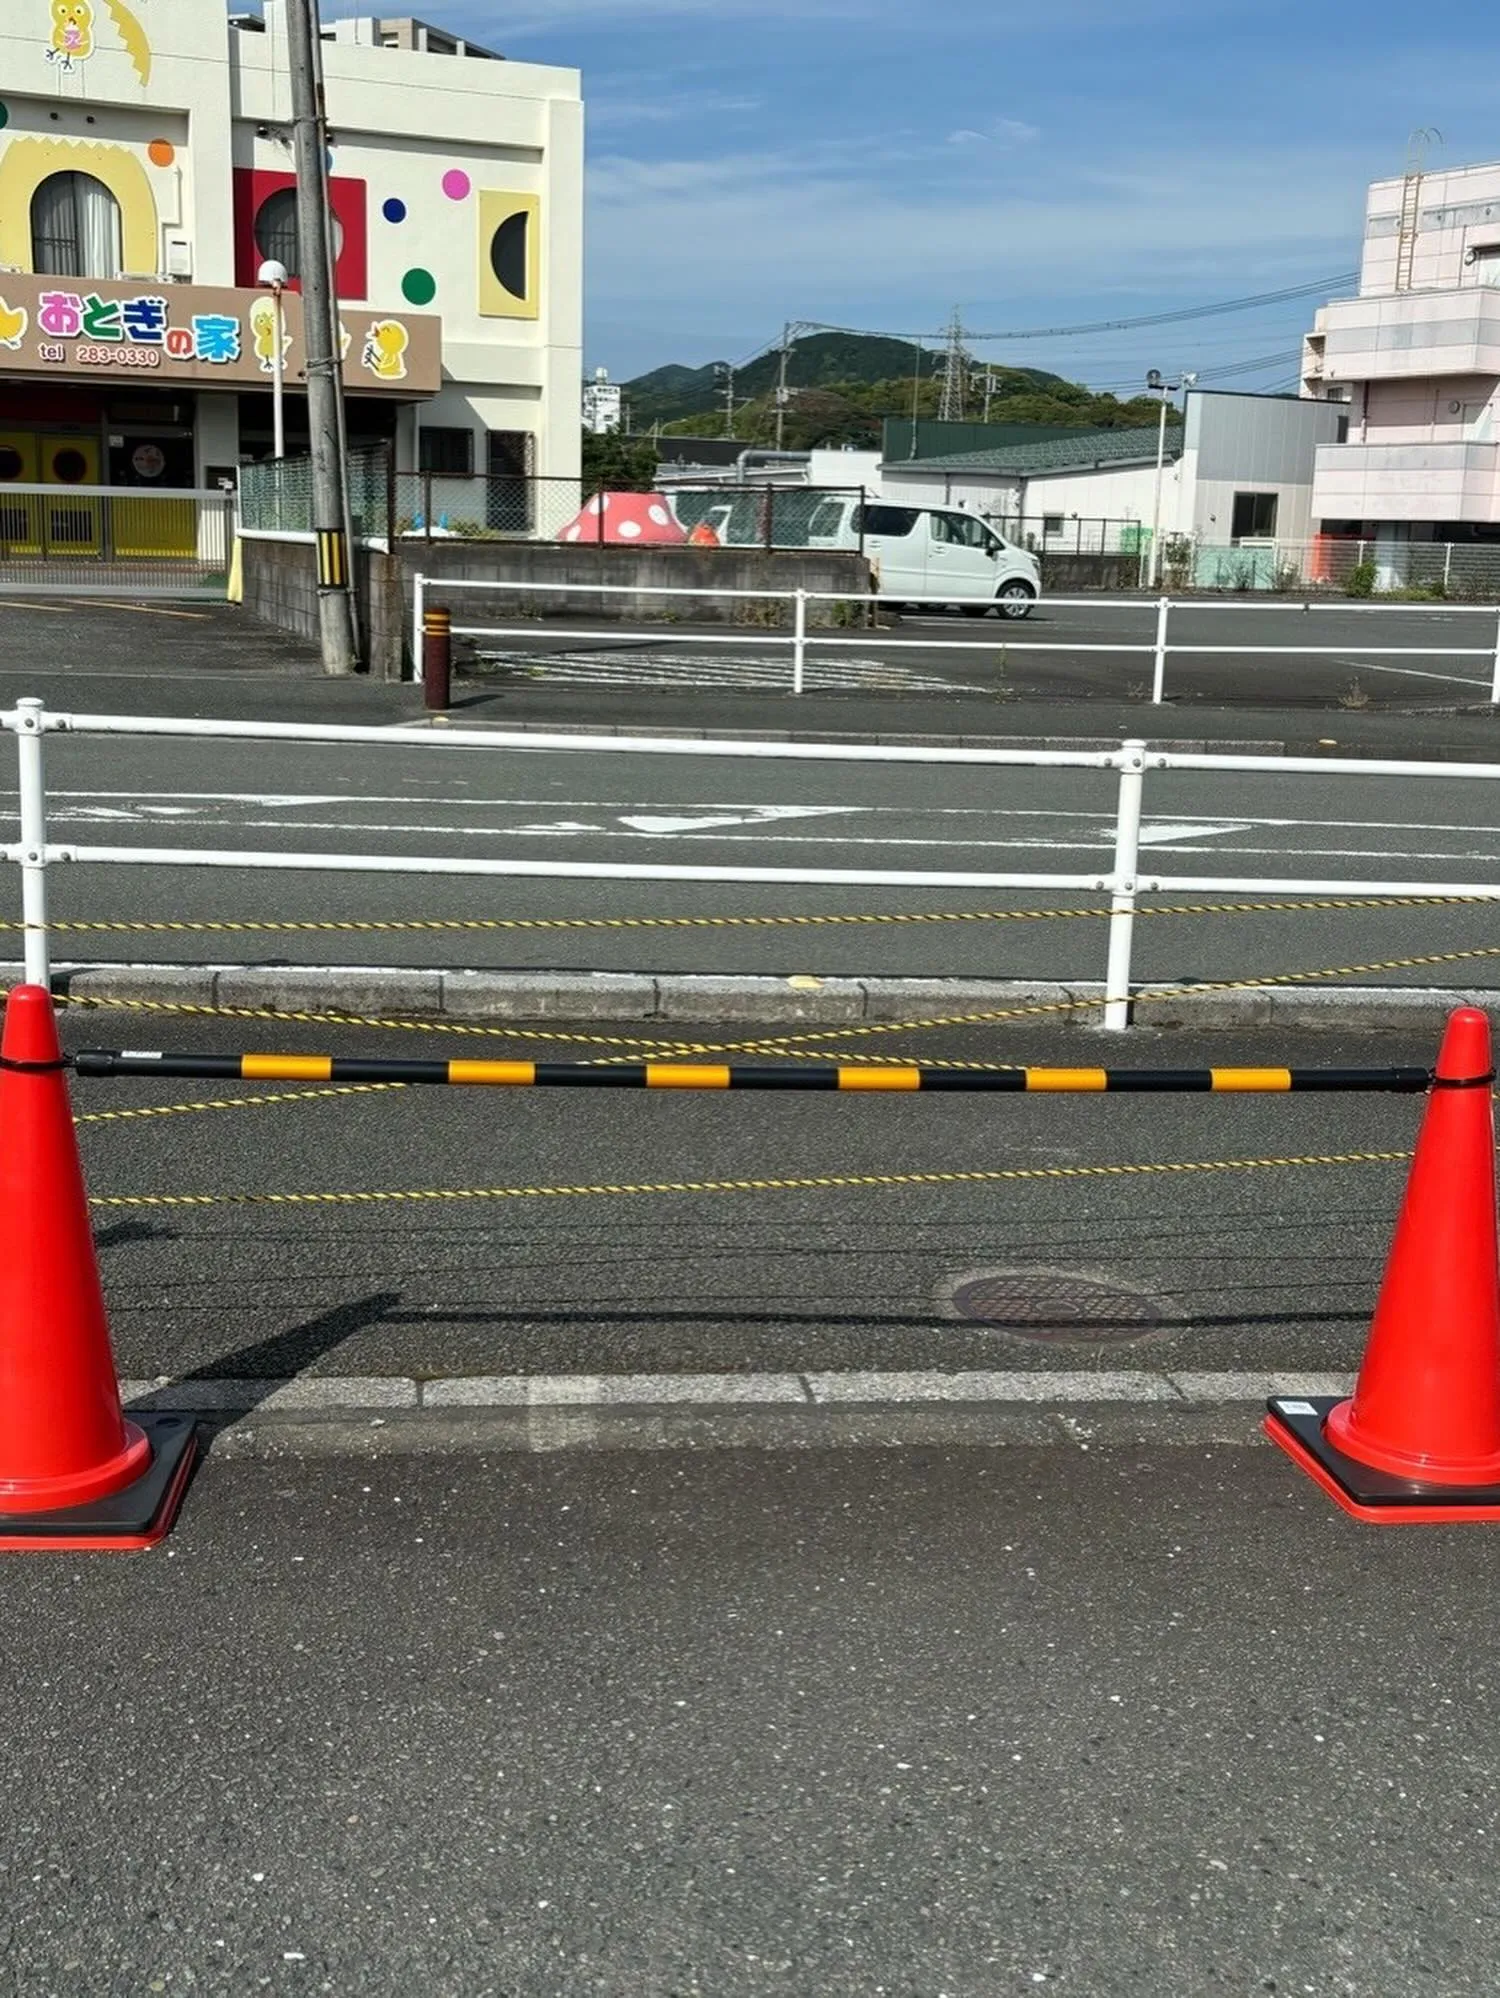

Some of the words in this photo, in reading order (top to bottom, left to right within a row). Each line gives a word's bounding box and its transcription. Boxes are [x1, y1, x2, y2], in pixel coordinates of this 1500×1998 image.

[39, 292, 240, 362] おとぎの家
[39, 344, 63, 360] tel
[77, 347, 158, 365] 283-0330
